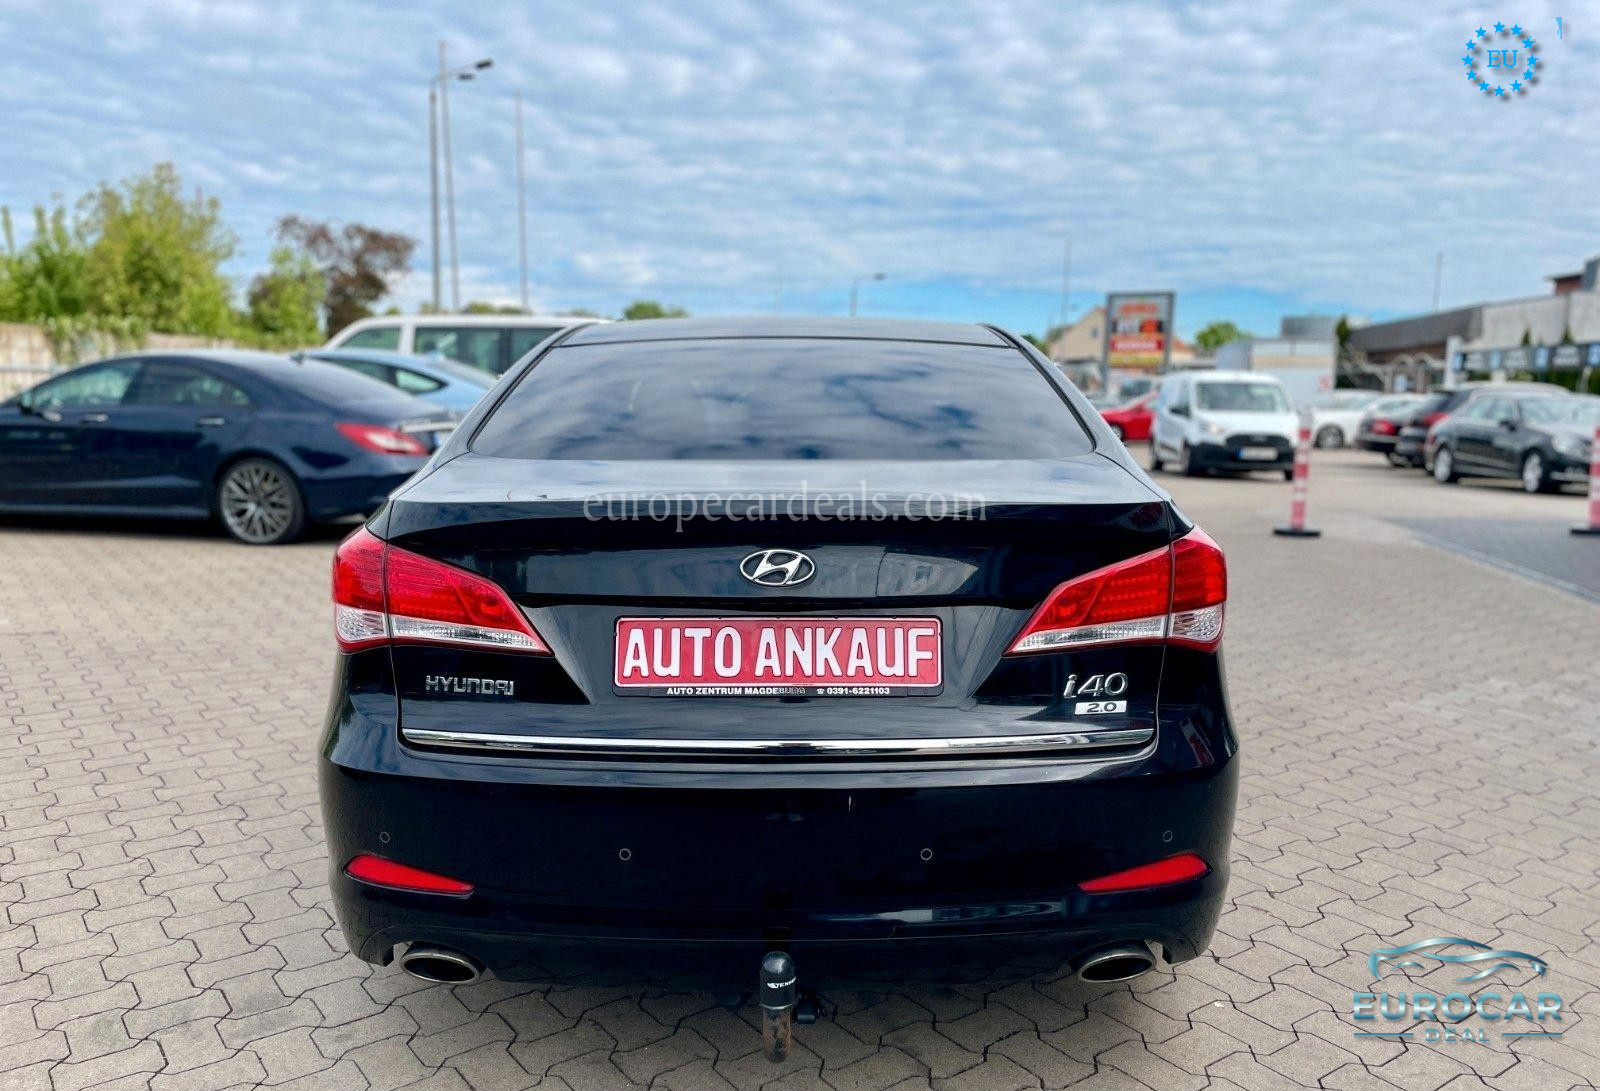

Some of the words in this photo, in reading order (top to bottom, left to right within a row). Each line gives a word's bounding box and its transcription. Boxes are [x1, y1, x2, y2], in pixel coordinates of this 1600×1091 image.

[622, 626, 742, 678] AUTO
[754, 626, 935, 678] ANKAUF
[425, 675, 515, 696] HYUNDAI
[666, 687, 694, 695] AUTO
[695, 687, 742, 695] ZENTRUM
[826, 687, 890, 695] 0391-6221103
[1063, 672, 1128, 699] i40
[1086, 702, 1117, 713] 2.0
